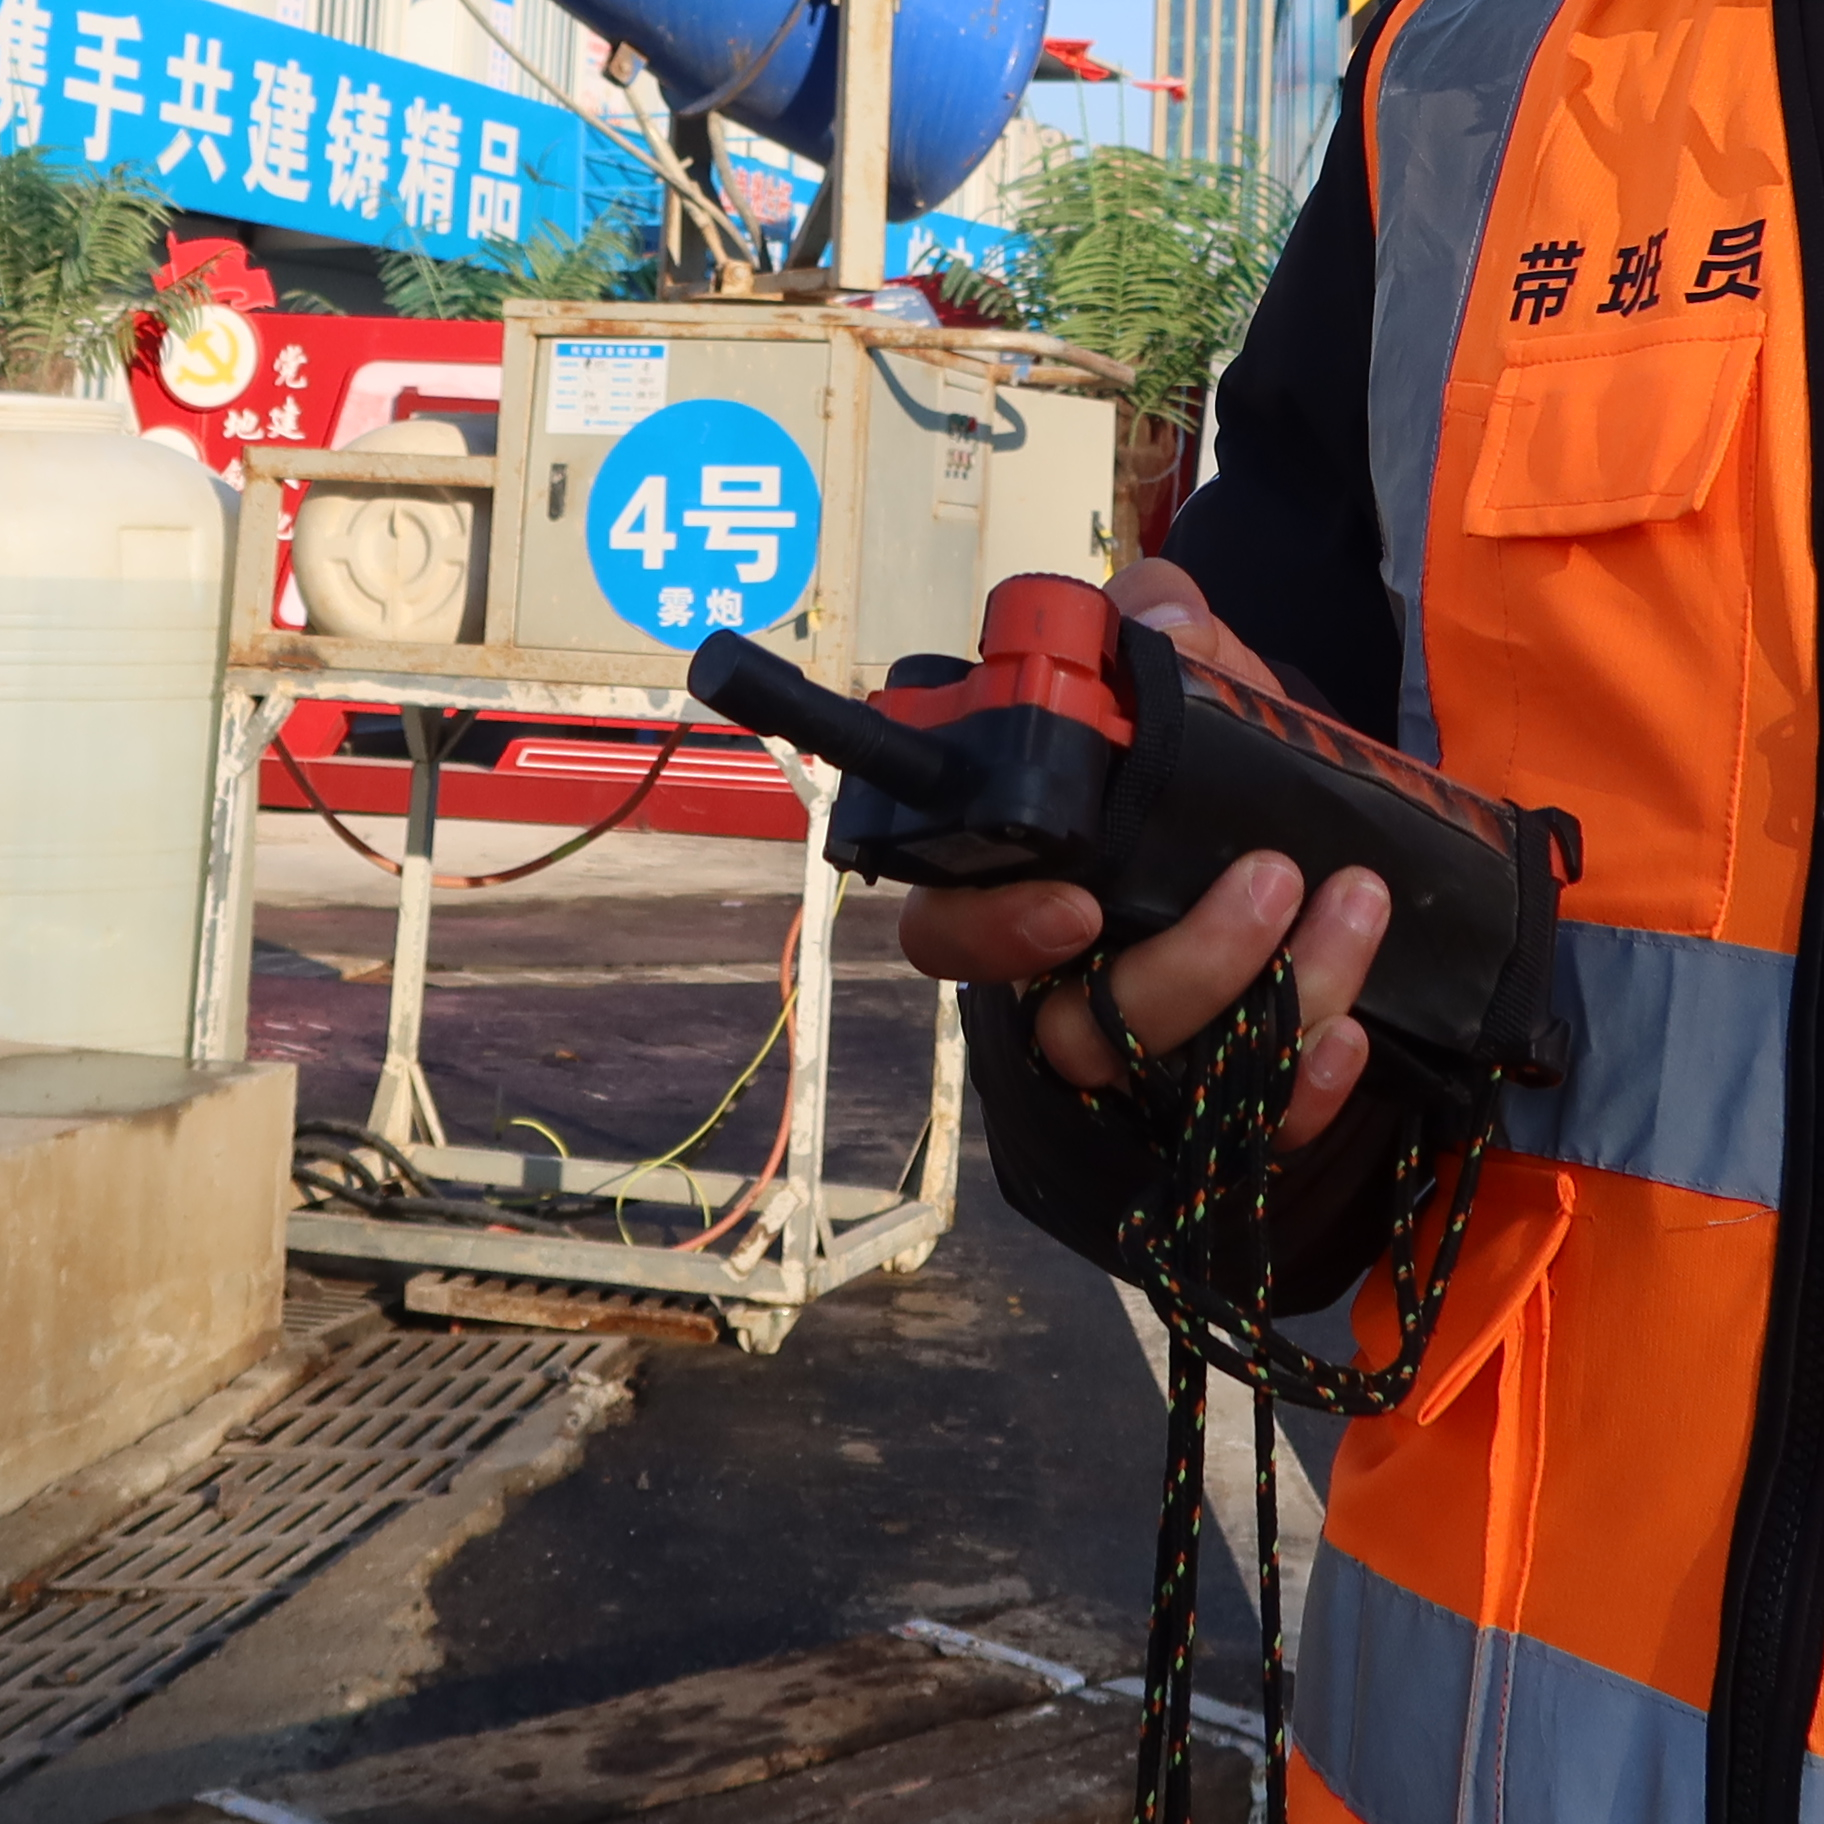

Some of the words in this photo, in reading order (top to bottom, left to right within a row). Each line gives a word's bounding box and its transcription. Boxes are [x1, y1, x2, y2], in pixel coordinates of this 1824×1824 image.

[1509, 218, 1767, 325] 带班员
[609, 465, 797, 584] 4号
[657, 587, 745, 628] 雾炮
